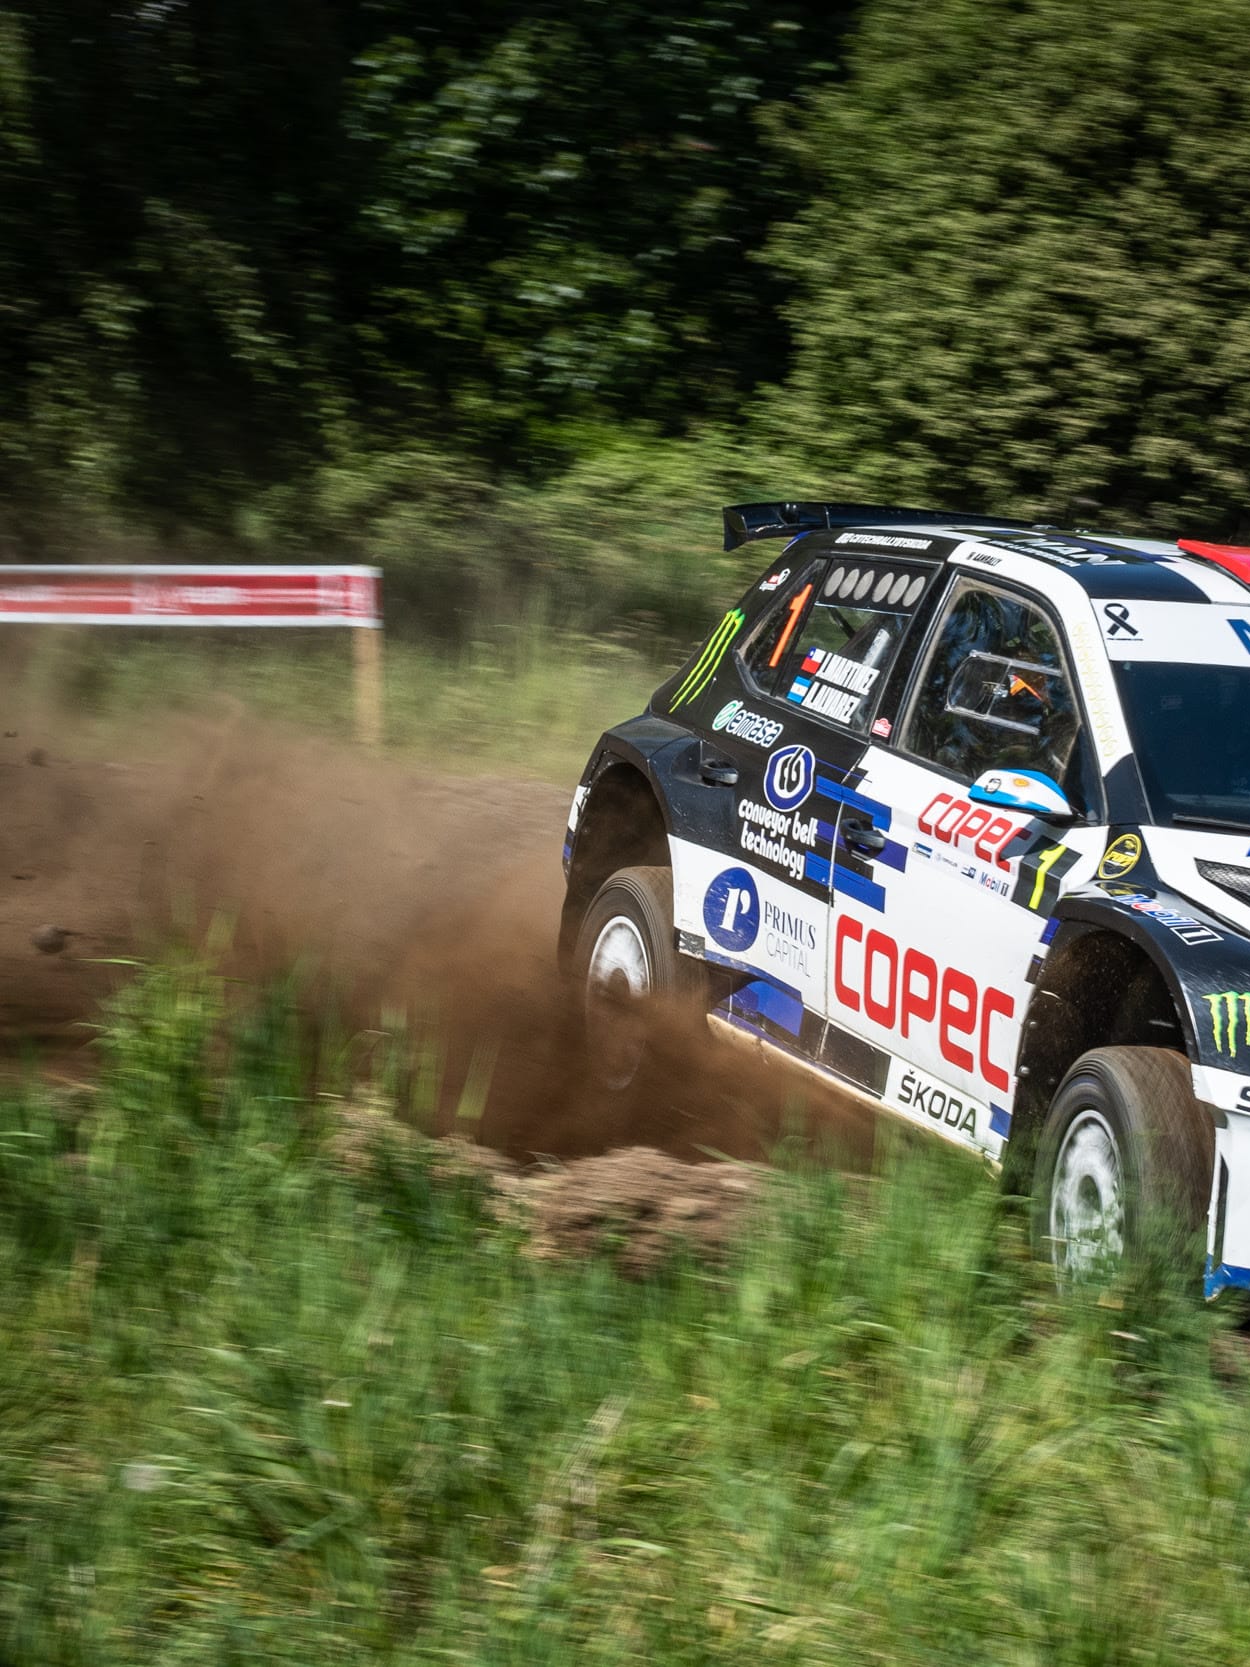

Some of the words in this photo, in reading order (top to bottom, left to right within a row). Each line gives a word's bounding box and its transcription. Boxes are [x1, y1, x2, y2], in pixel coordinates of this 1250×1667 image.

[768, 583, 814, 668] 1
[726, 709, 784, 748] emasa
[738, 799, 792, 838] conveyor
[792, 811, 818, 847] belt
[741, 821, 805, 880] technology
[1028, 844, 1068, 910] 1
[764, 901, 816, 950] PRIMUS
[765, 932, 811, 978] CAPITAL
[897, 1070, 977, 1139] ŠKODA
